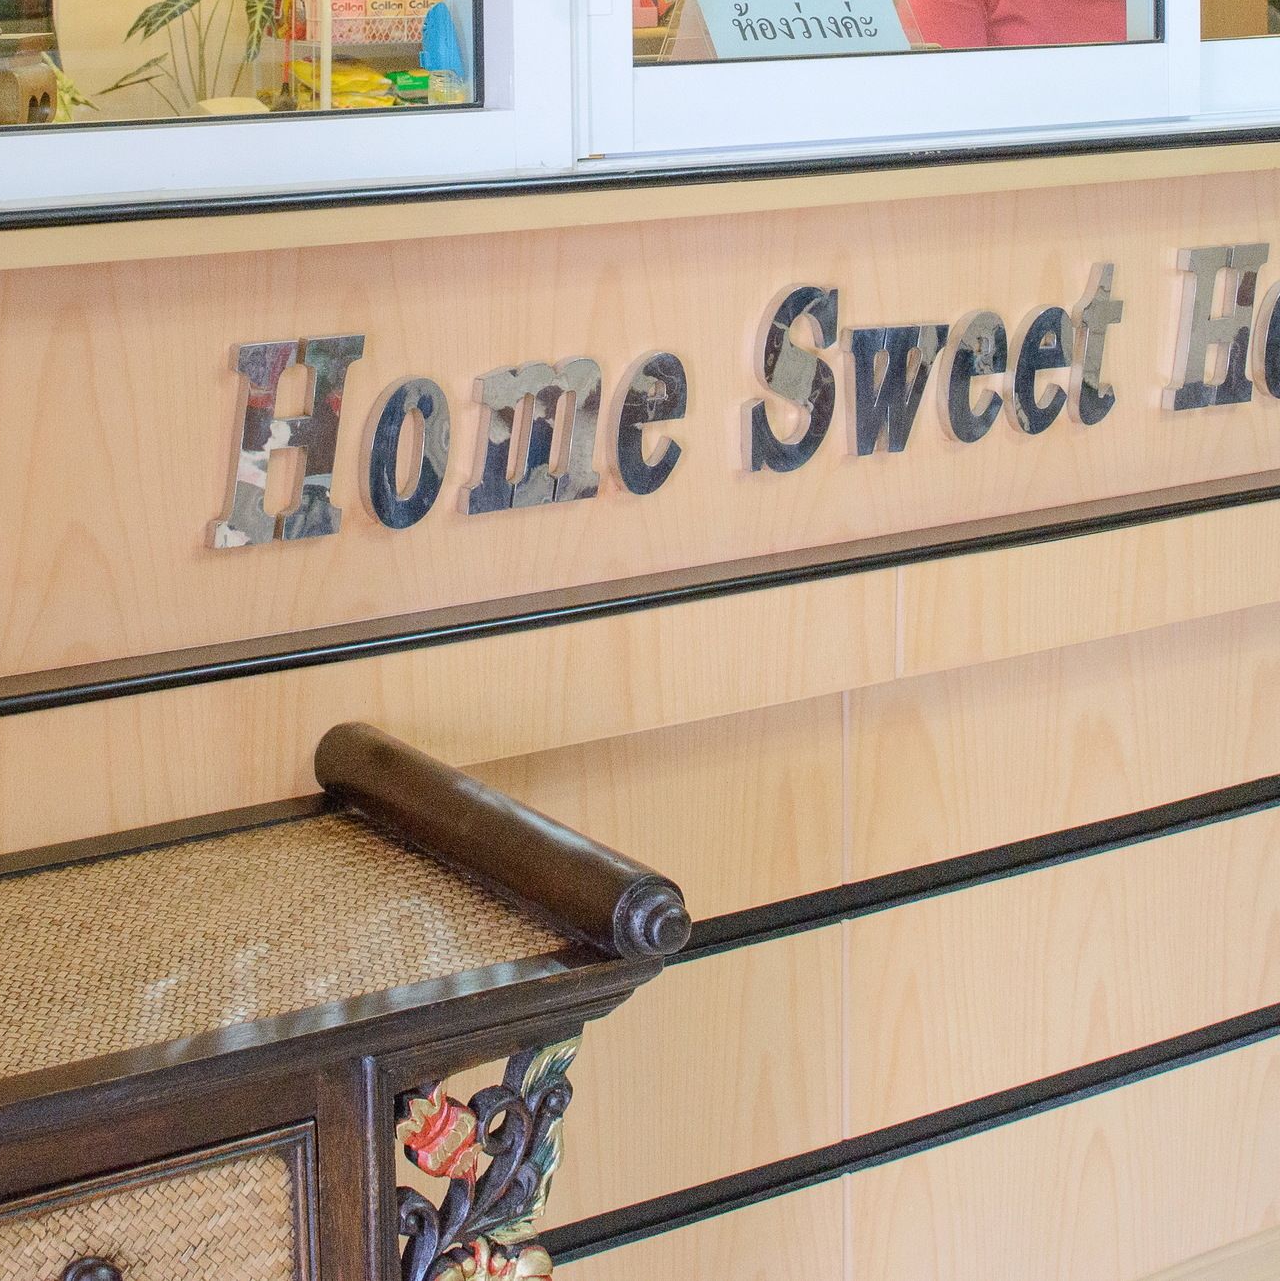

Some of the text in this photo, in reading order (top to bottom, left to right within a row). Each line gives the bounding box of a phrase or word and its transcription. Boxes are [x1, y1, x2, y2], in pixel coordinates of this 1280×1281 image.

[331, 2, 363, 12] Collon
[371, 1, 403, 10] Collon
[732, 1, 878, 41] ห้องว่างค่ะ
[206, 333, 688, 549] Home
[741, 262, 1121, 472] Sweet
